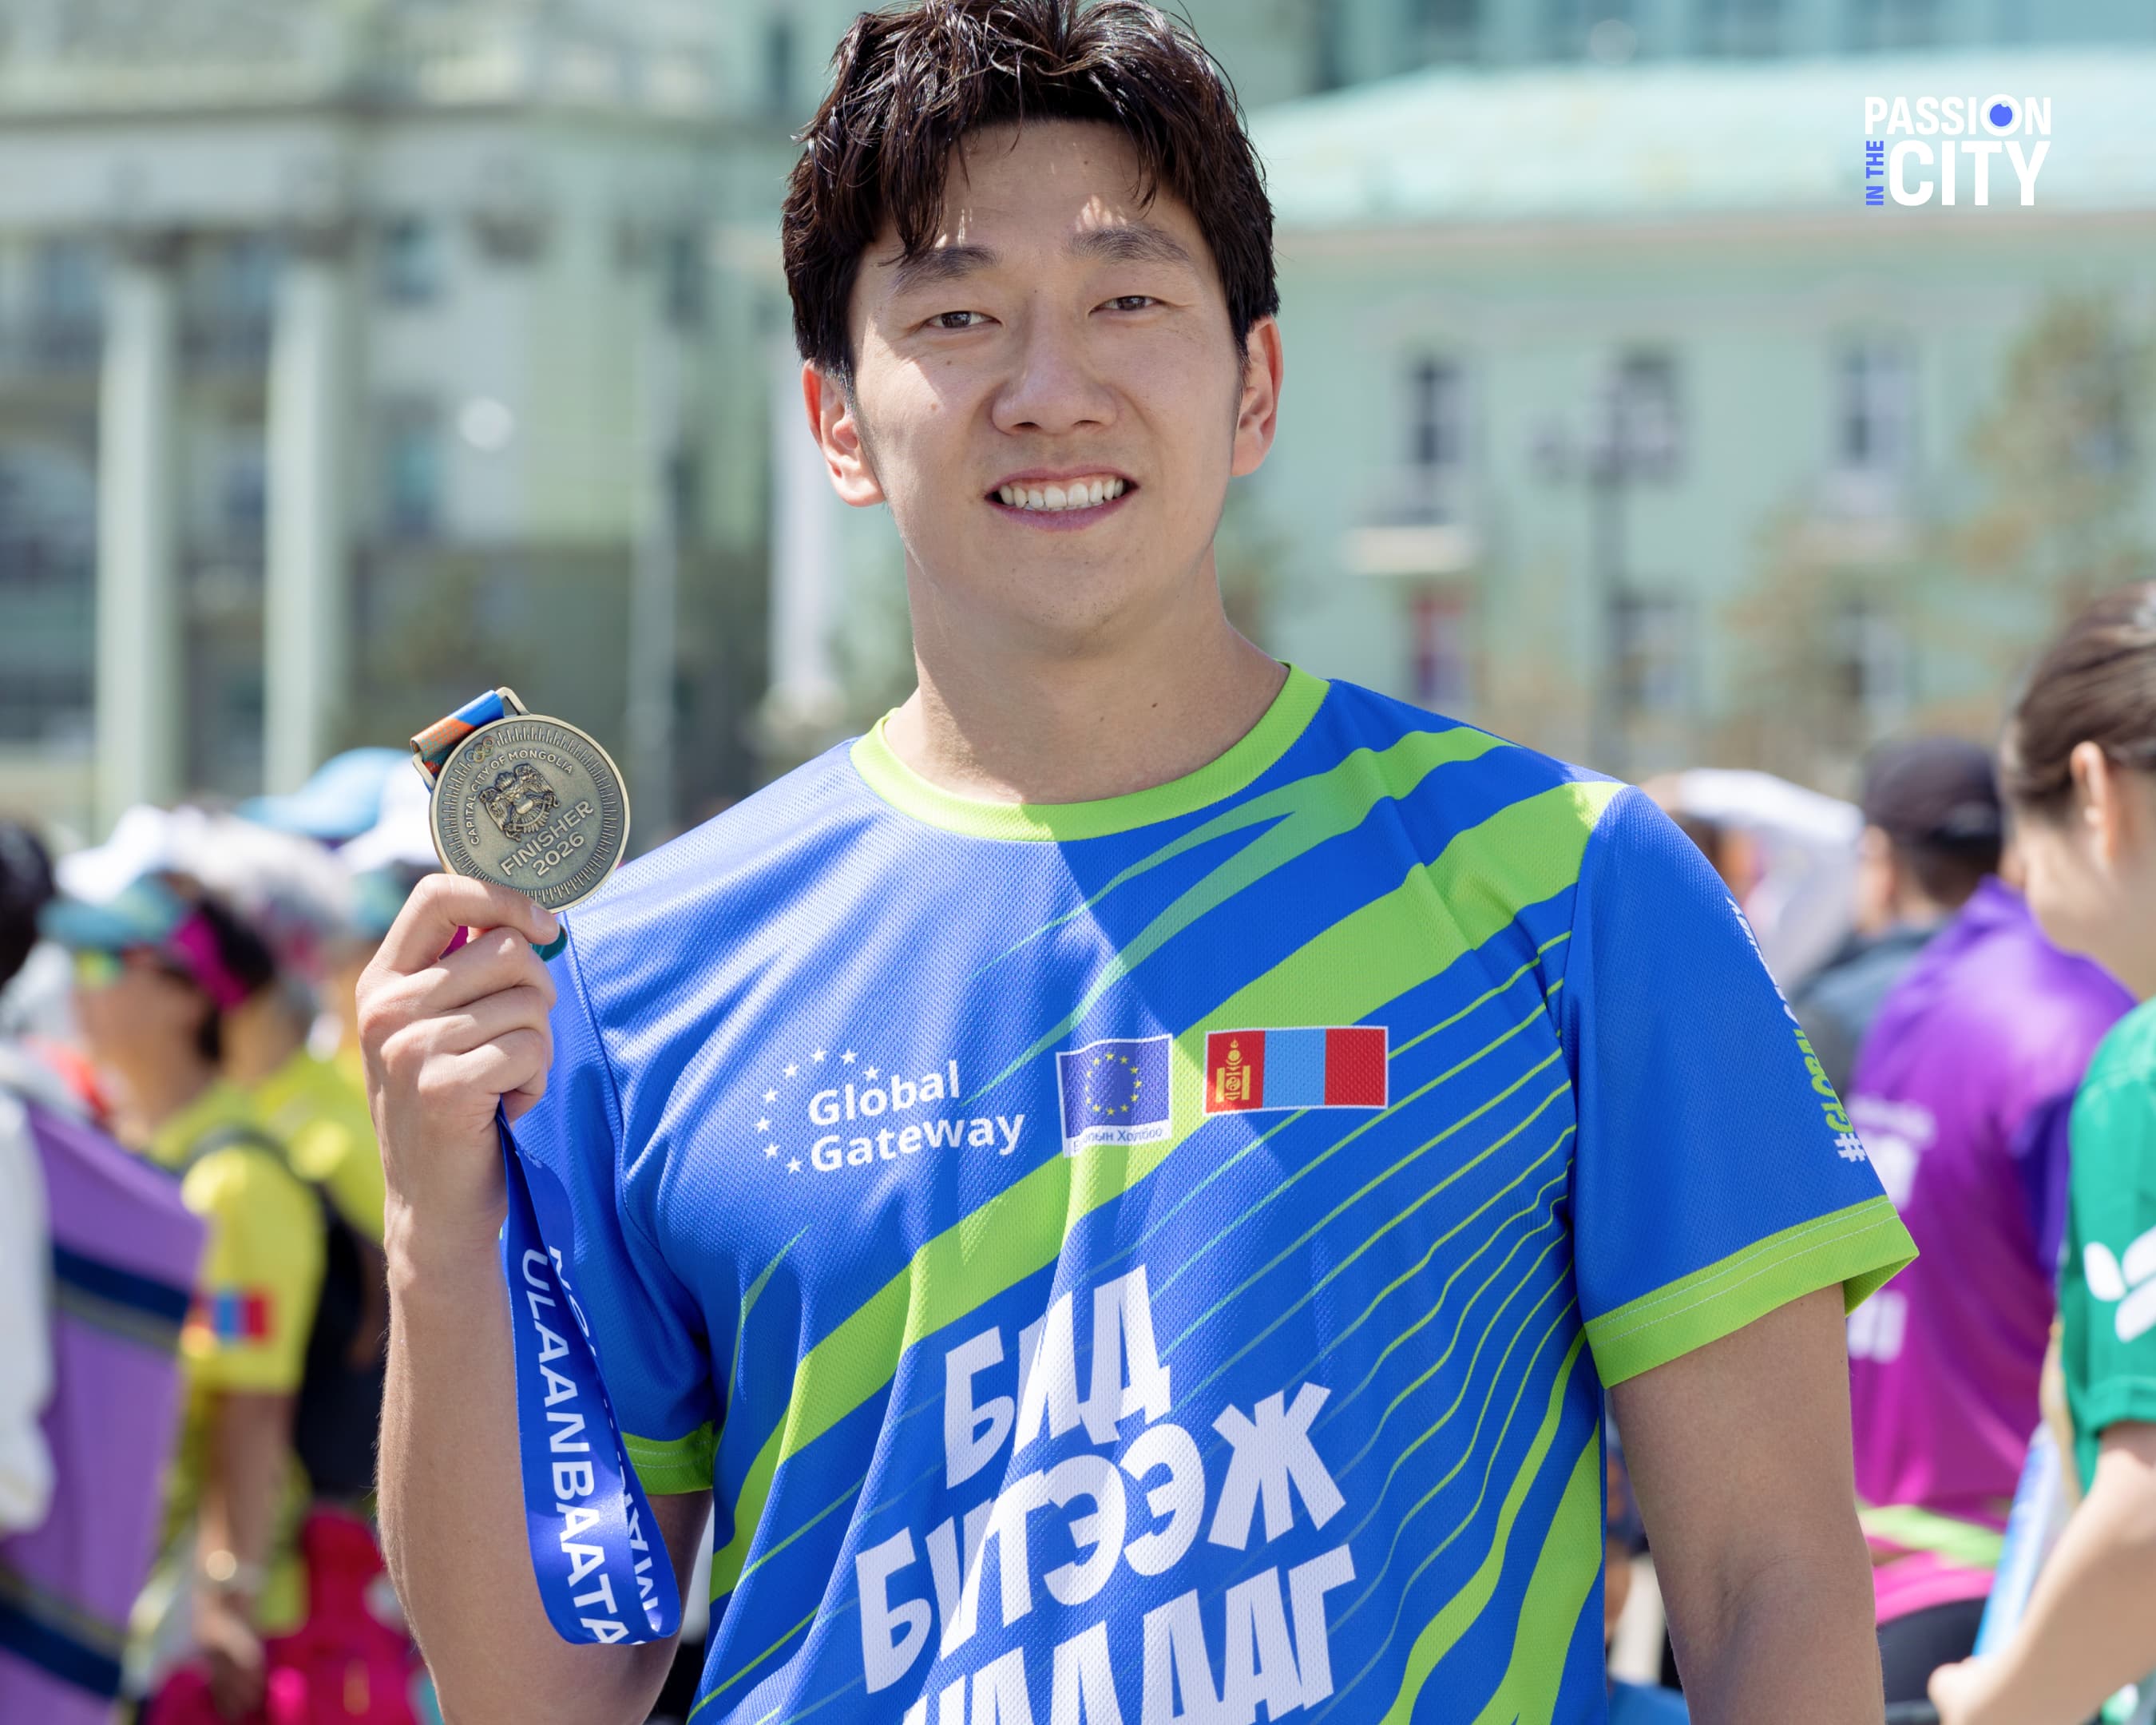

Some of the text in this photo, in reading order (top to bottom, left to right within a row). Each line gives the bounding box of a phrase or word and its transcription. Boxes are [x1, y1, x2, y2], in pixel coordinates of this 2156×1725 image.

[465, 750, 573, 845] CAPITAL CITY OF MONGOLIA
[500, 800, 594, 876] FINISHER
[532, 831, 585, 876] 2026
[808, 1060, 960, 1126] Global
[810, 1113, 1025, 1172] Gateway
[944, 1263, 1171, 1490] БИД
[522, 1248, 646, 1645] ULAANBAATA
